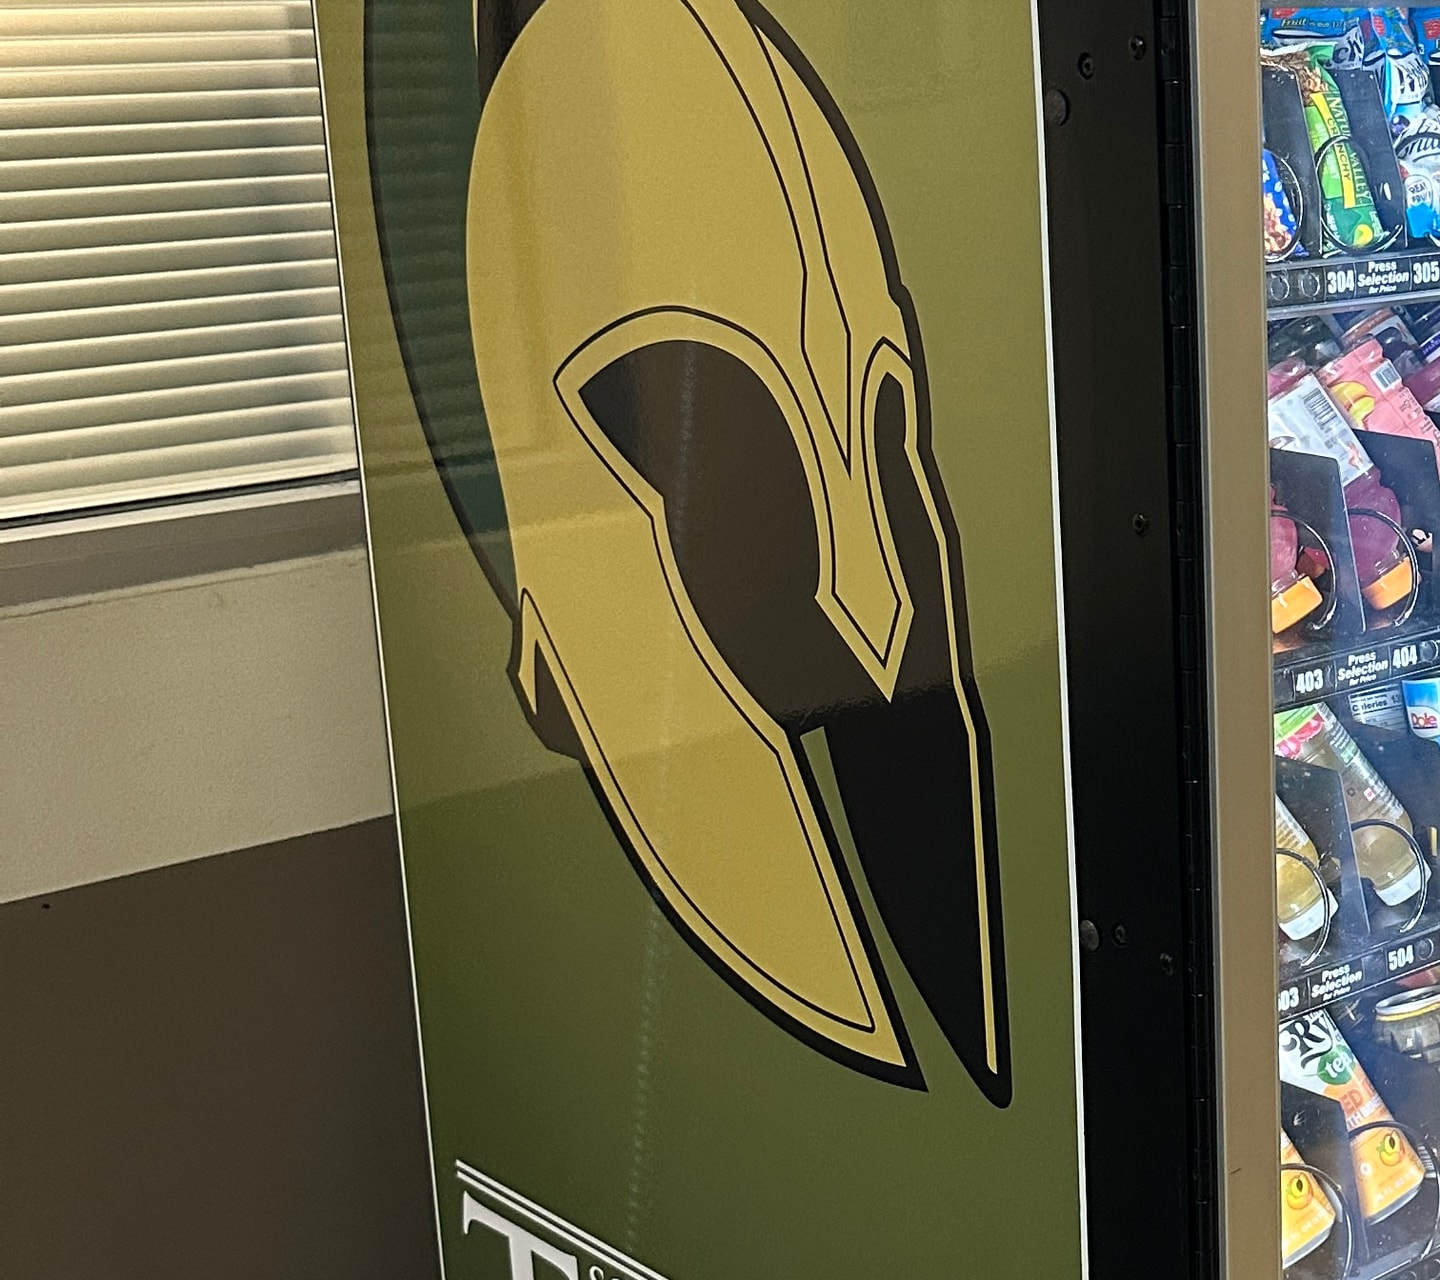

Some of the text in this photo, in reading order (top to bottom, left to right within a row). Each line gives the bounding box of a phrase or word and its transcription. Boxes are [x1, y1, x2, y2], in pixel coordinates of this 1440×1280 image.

[1280, 18, 1307, 29] Fruit
[1326, 96, 1352, 138] NATU
[1326, 117, 1352, 182] CRNCHY
[1350, 151, 1373, 199] VALLEY
[1368, 260, 1398, 274] Press
[1412, 260, 1440, 285] 305
[1328, 270, 1355, 295] 304
[1357, 272, 1410, 289] Selection
[1347, 650, 1377, 666] Press
[1392, 645, 1418, 669] 404
[1295, 669, 1324, 694] 403
[1337, 660, 1389, 681] Selection
[1351, 700, 1388, 713] Clories
[1410, 712, 1438, 727] Dole
[1388, 945, 1415, 971] 504
[1310, 970, 1363, 998] Selection
[1321, 963, 1351, 984] Press
[1325, 1052, 1353, 1079] tea
